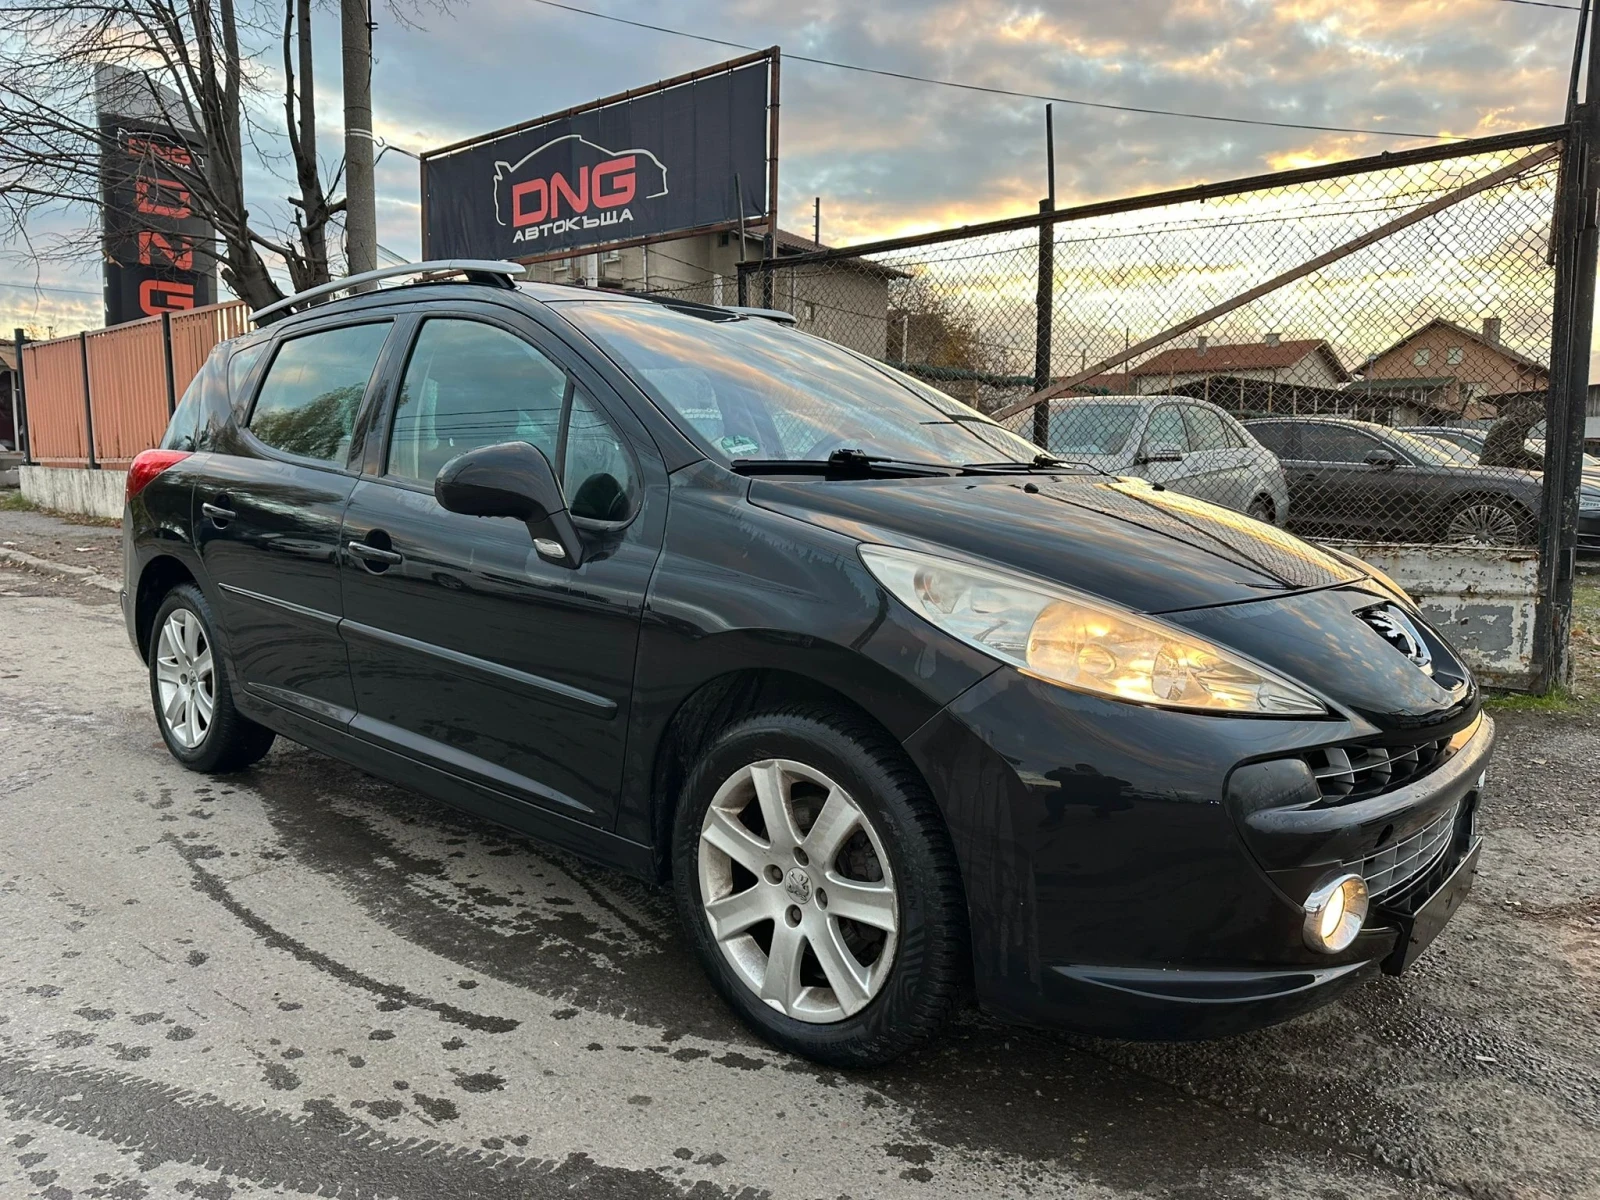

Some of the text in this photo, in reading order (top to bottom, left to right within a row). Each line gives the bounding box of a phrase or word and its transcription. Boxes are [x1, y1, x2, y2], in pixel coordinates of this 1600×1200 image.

[512, 154, 636, 228] DNG
[512, 208, 634, 244] АВТОКЪЩА
[135, 175, 194, 316] DNG
